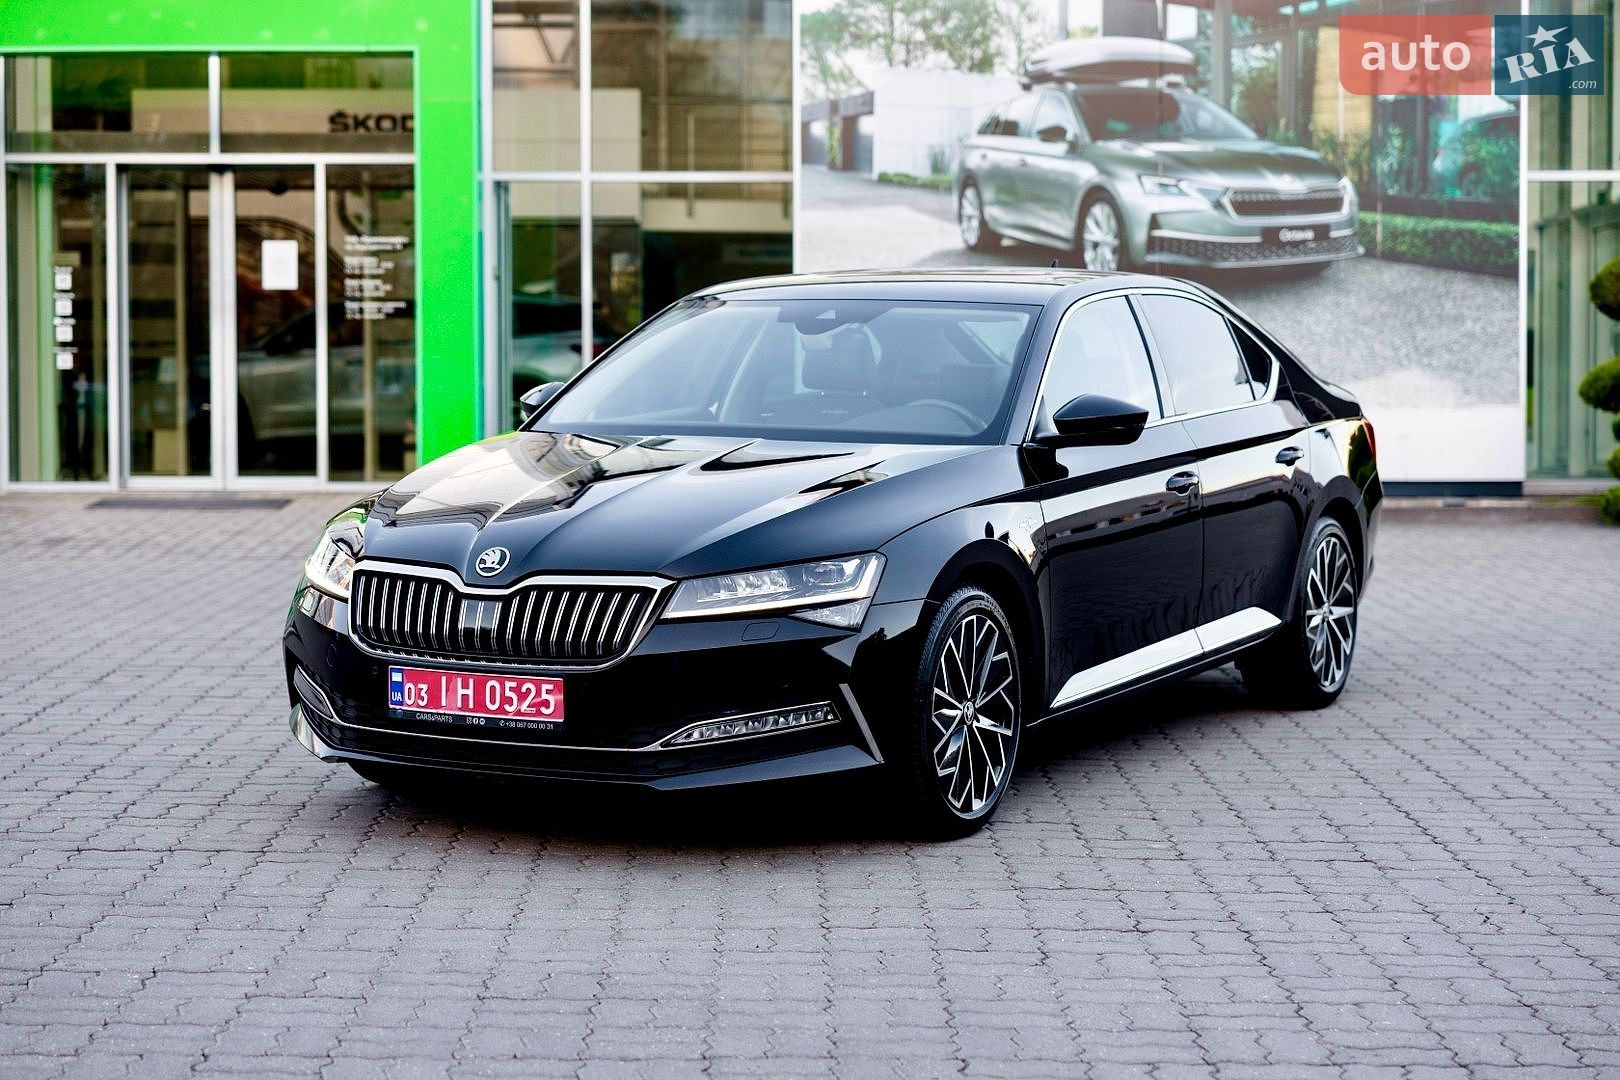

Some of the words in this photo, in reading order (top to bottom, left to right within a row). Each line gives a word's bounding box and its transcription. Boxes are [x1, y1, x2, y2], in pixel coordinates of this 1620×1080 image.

[391, 691, 402, 702] UA
[404, 682, 429, 707] 03
[485, 679, 556, 715] 0525
